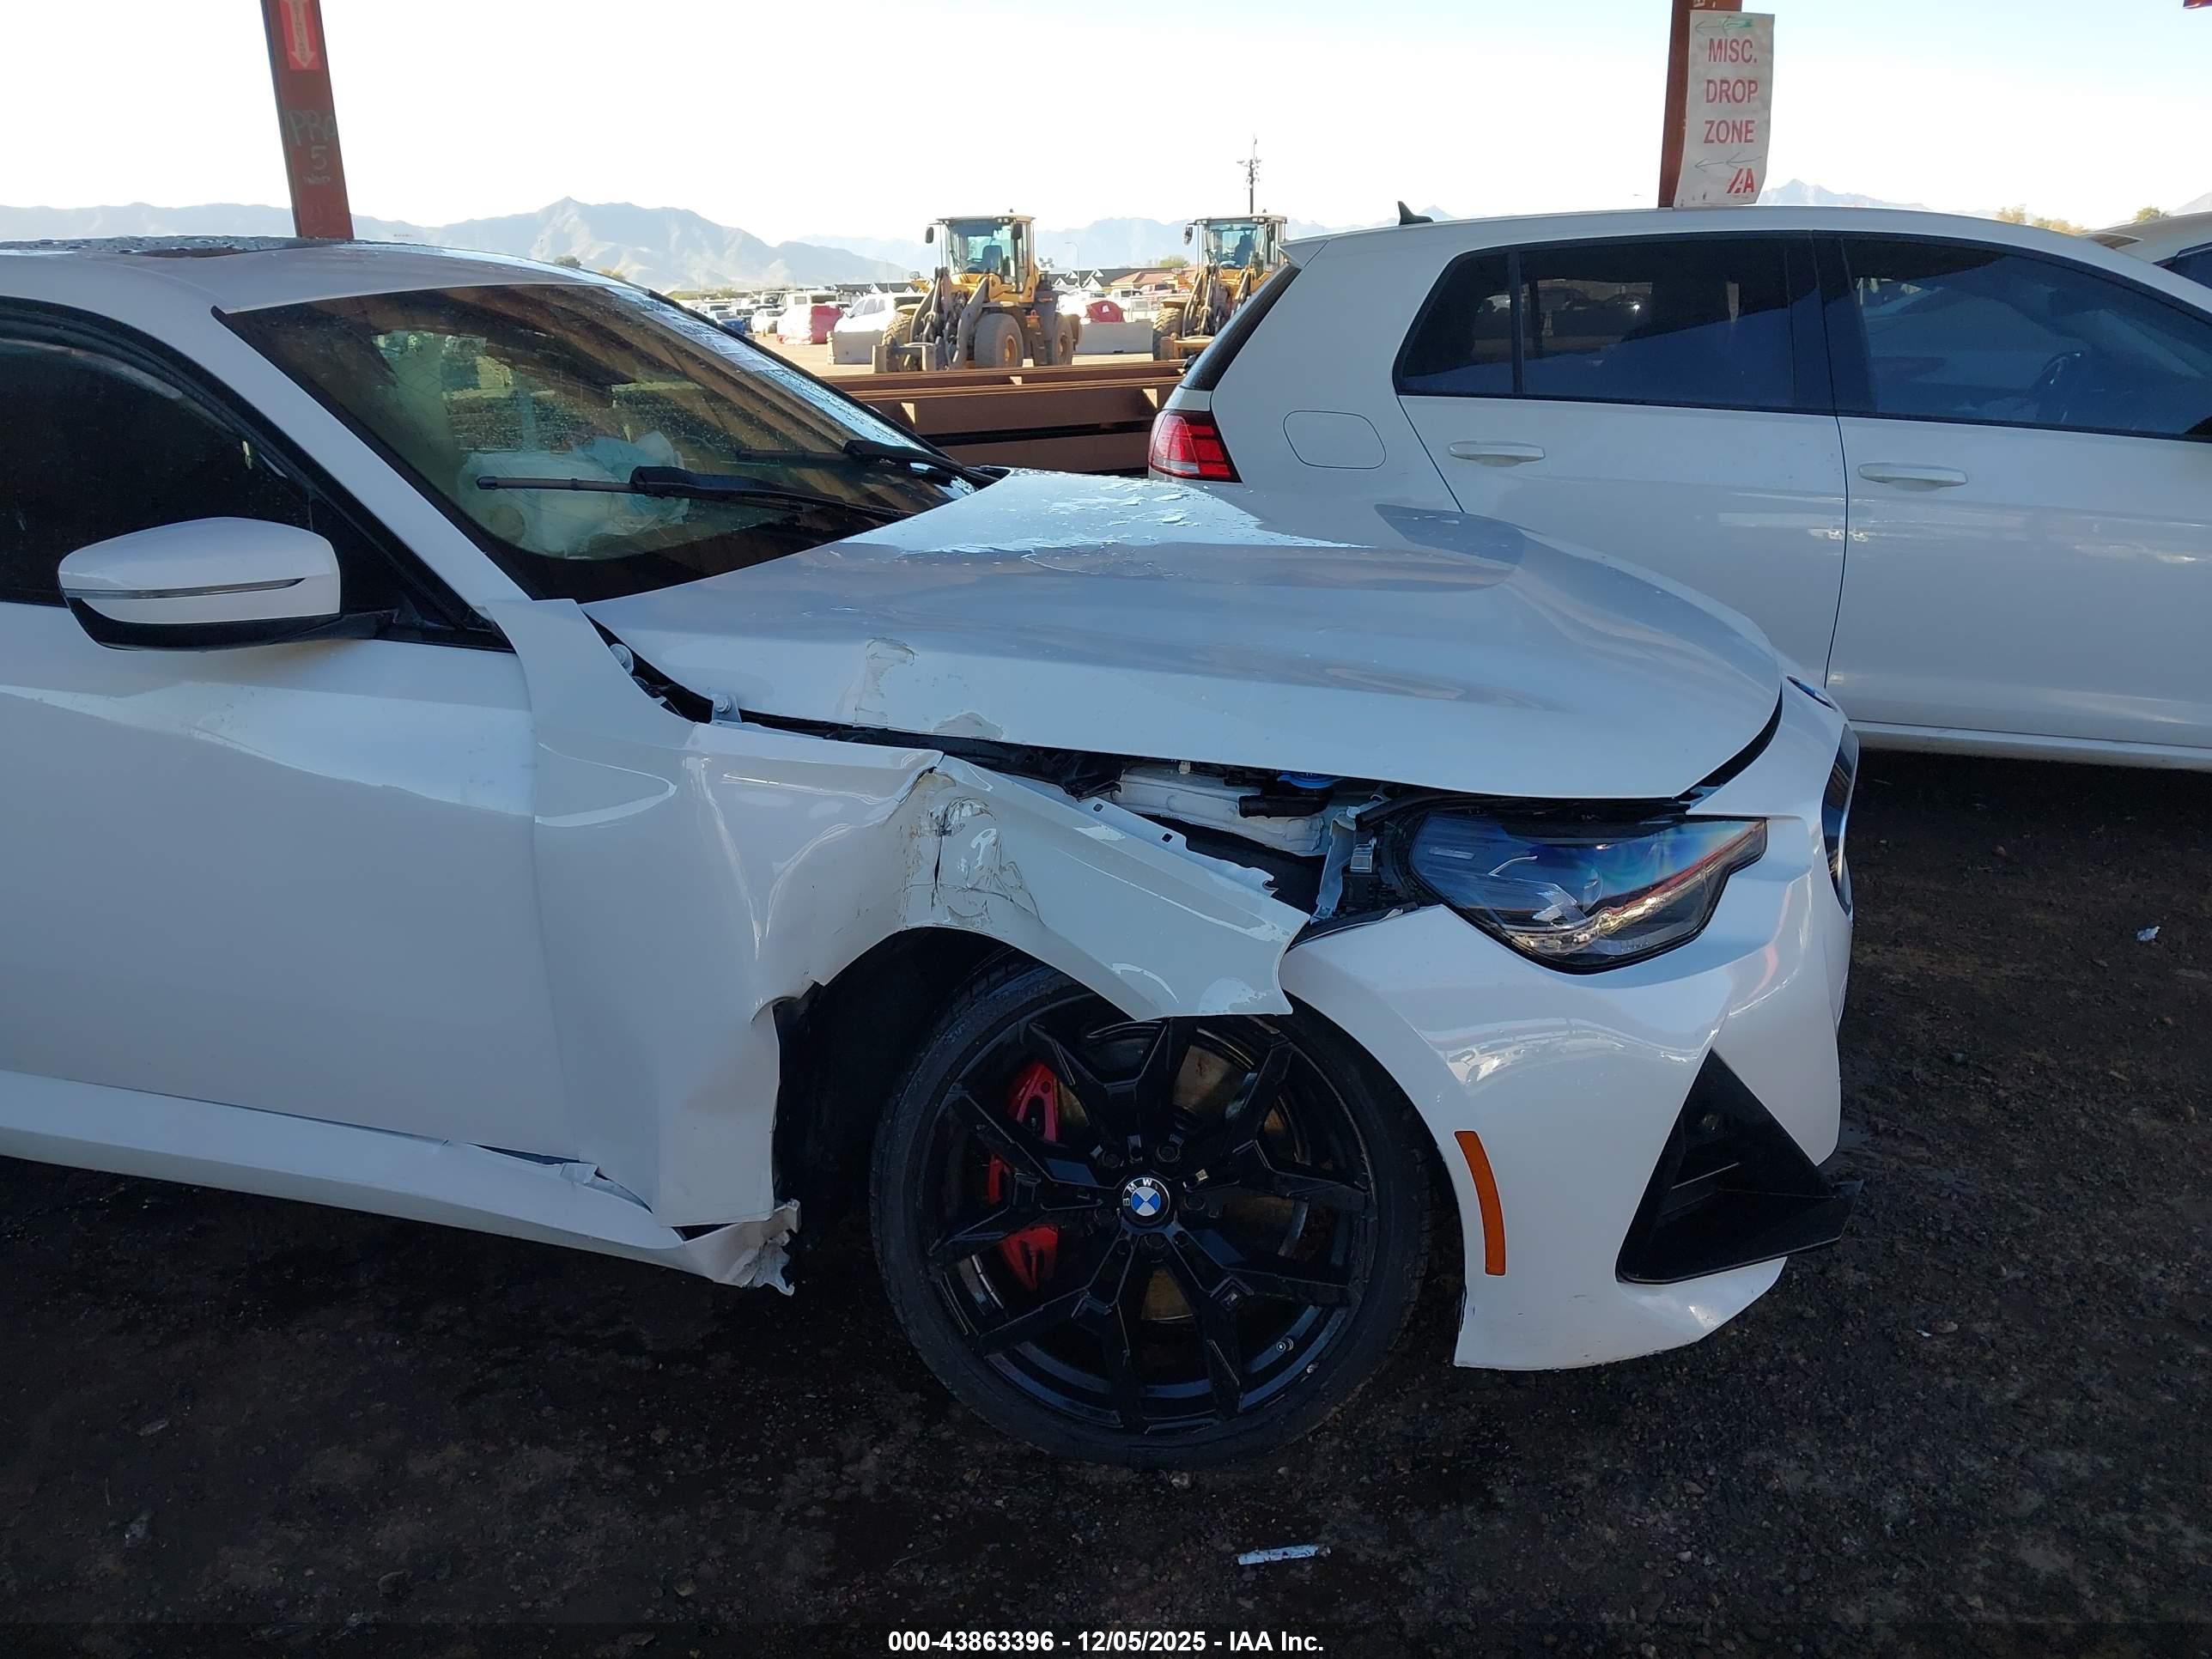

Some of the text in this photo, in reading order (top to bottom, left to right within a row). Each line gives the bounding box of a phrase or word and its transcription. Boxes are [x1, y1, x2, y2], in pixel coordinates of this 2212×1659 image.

[1708, 38, 1758, 64] MISC.
[1705, 79, 1759, 104] DROP
[1703, 119, 1756, 144] ZONE
[310, 144, 328, 171] 5
